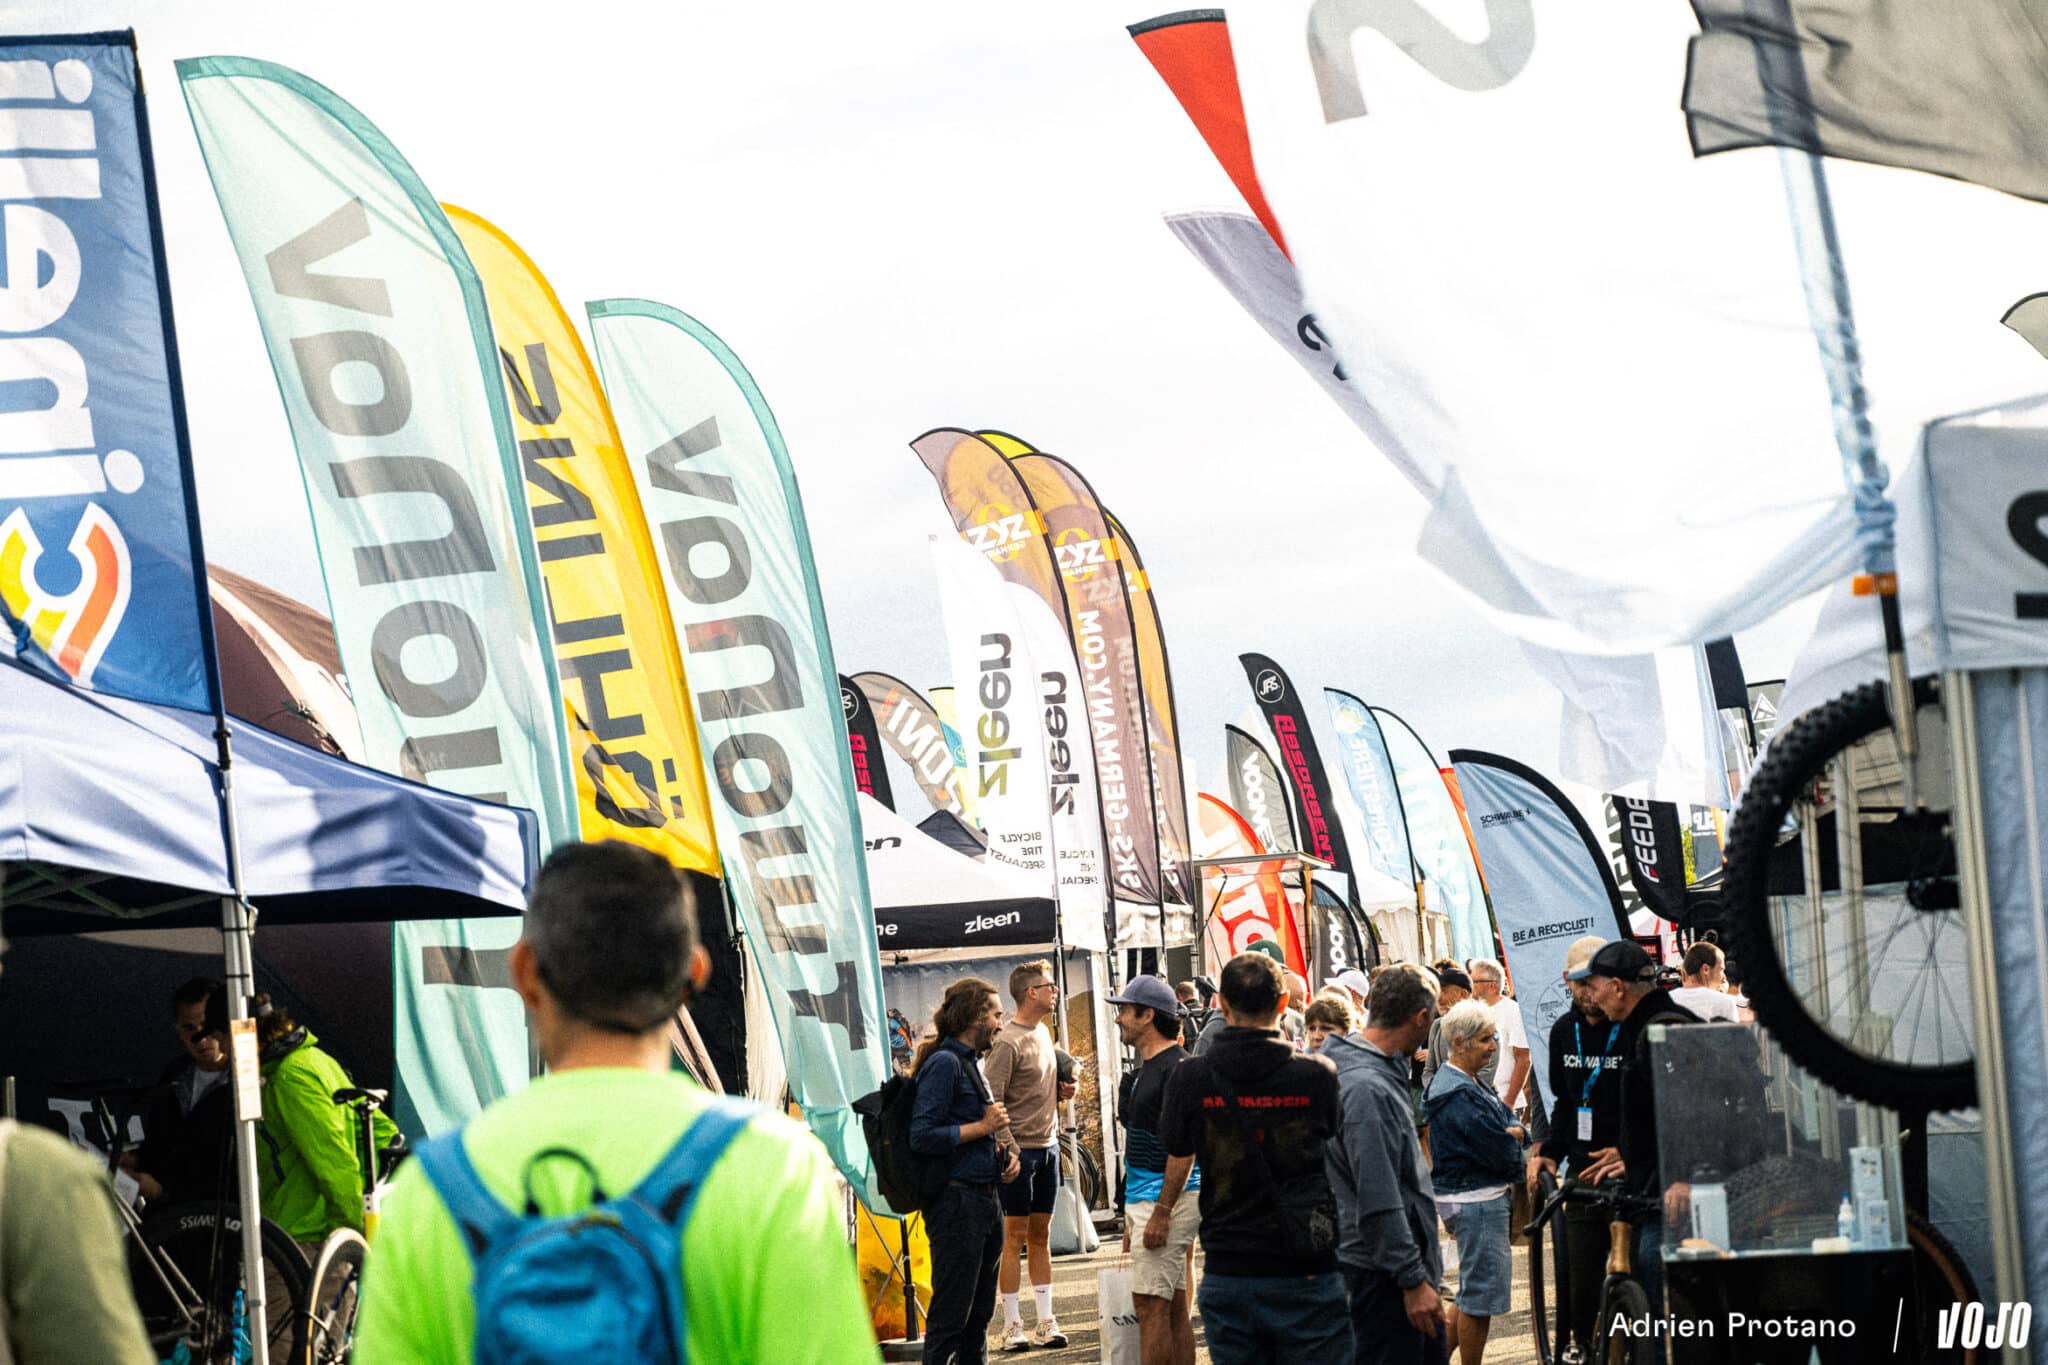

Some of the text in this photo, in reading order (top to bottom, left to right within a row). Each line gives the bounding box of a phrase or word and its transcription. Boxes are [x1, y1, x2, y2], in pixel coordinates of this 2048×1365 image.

[965, 909, 1021, 934] zleen
[1512, 930, 1526, 942] BE
[1528, 928, 1536, 939] A
